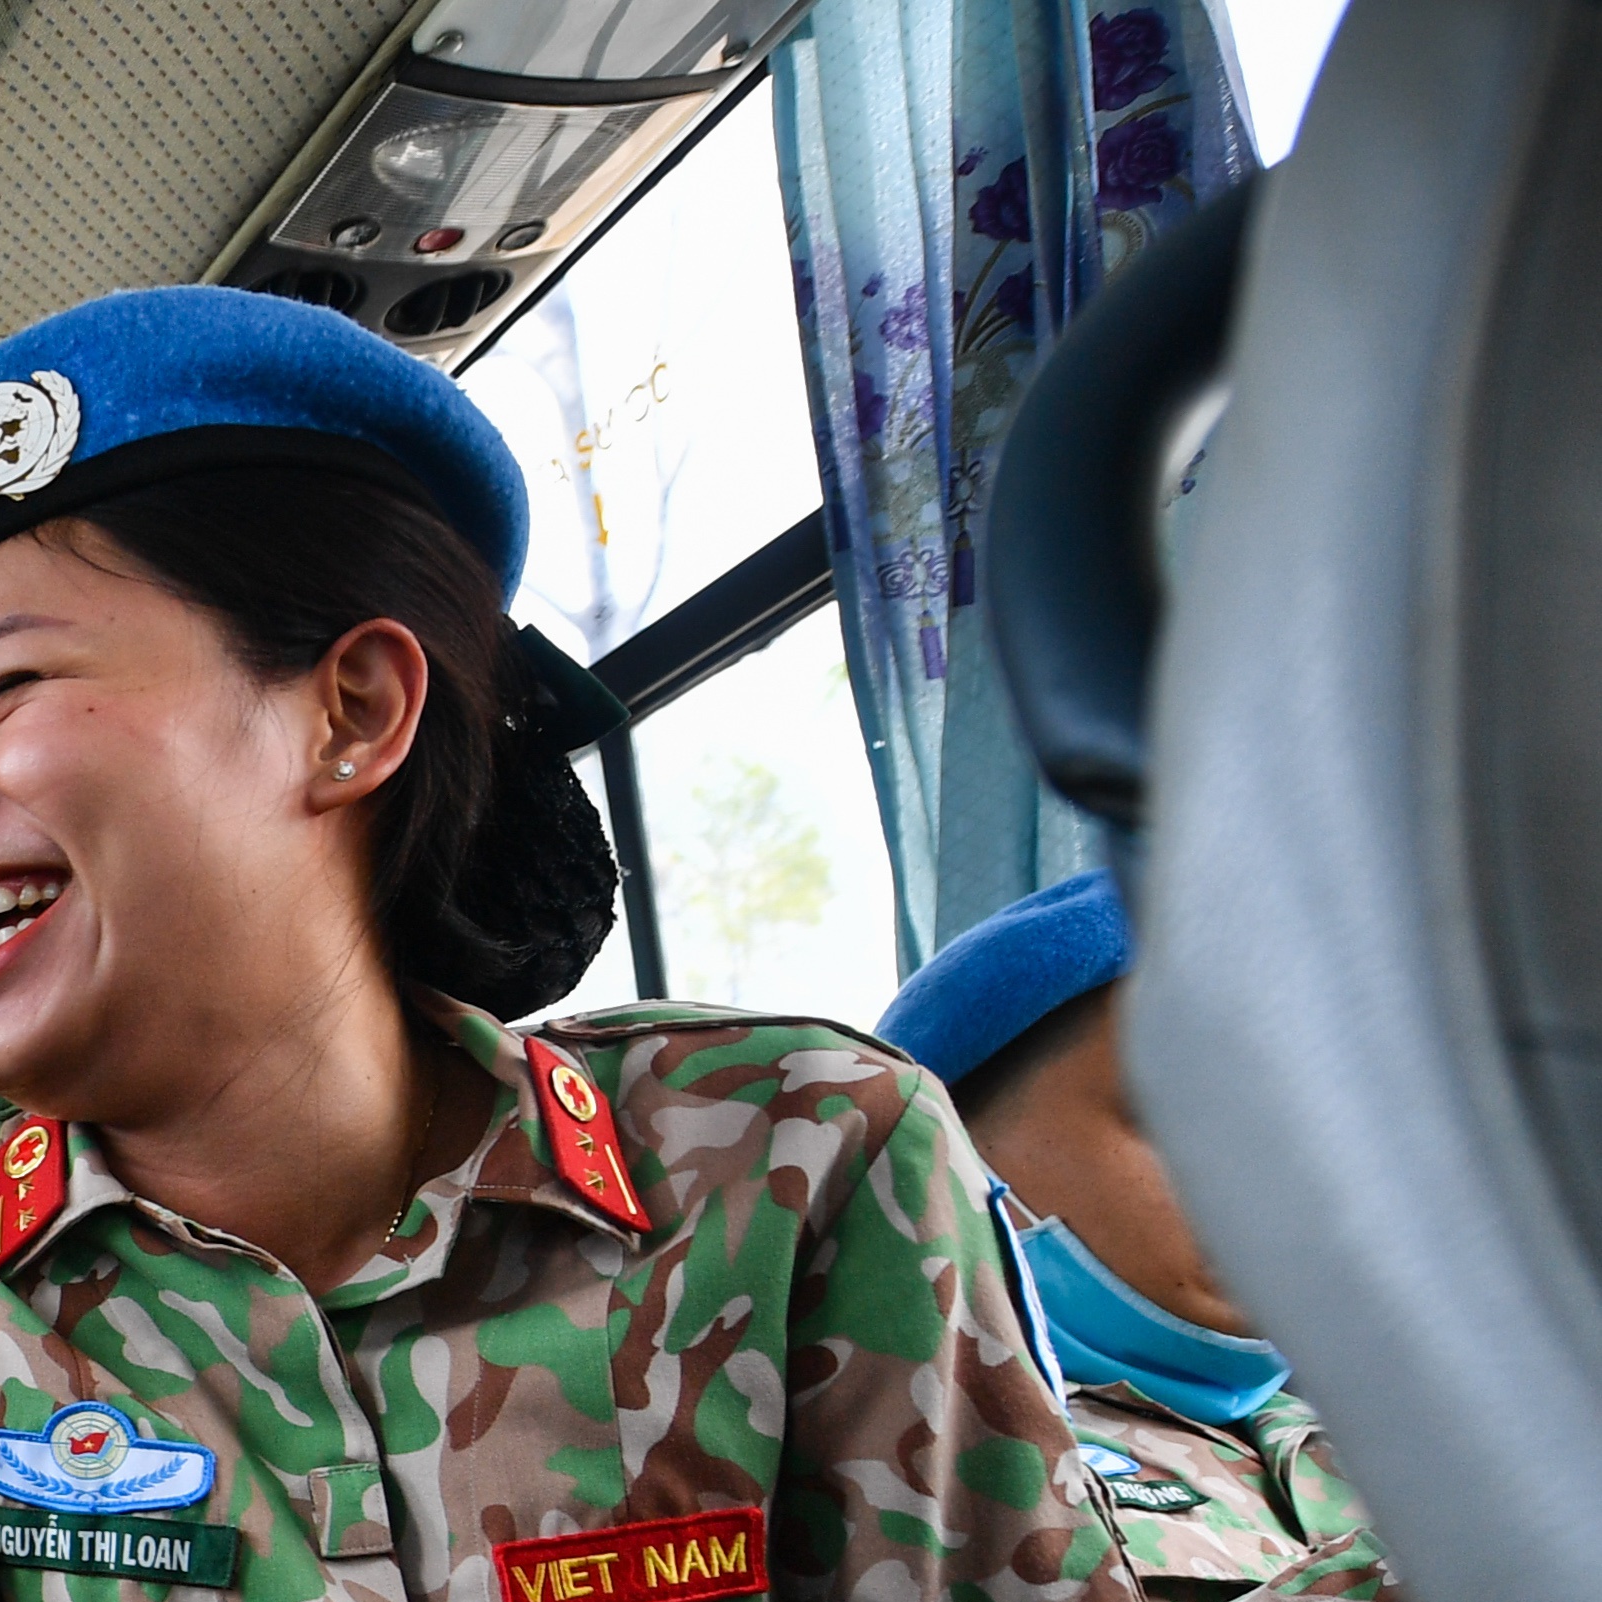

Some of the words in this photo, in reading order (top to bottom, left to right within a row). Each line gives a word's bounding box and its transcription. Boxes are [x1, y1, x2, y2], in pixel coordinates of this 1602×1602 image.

[77, 1529, 117, 1571] THỊ
[122, 1533, 191, 1573] LOAN
[643, 1531, 747, 1588] NAM
